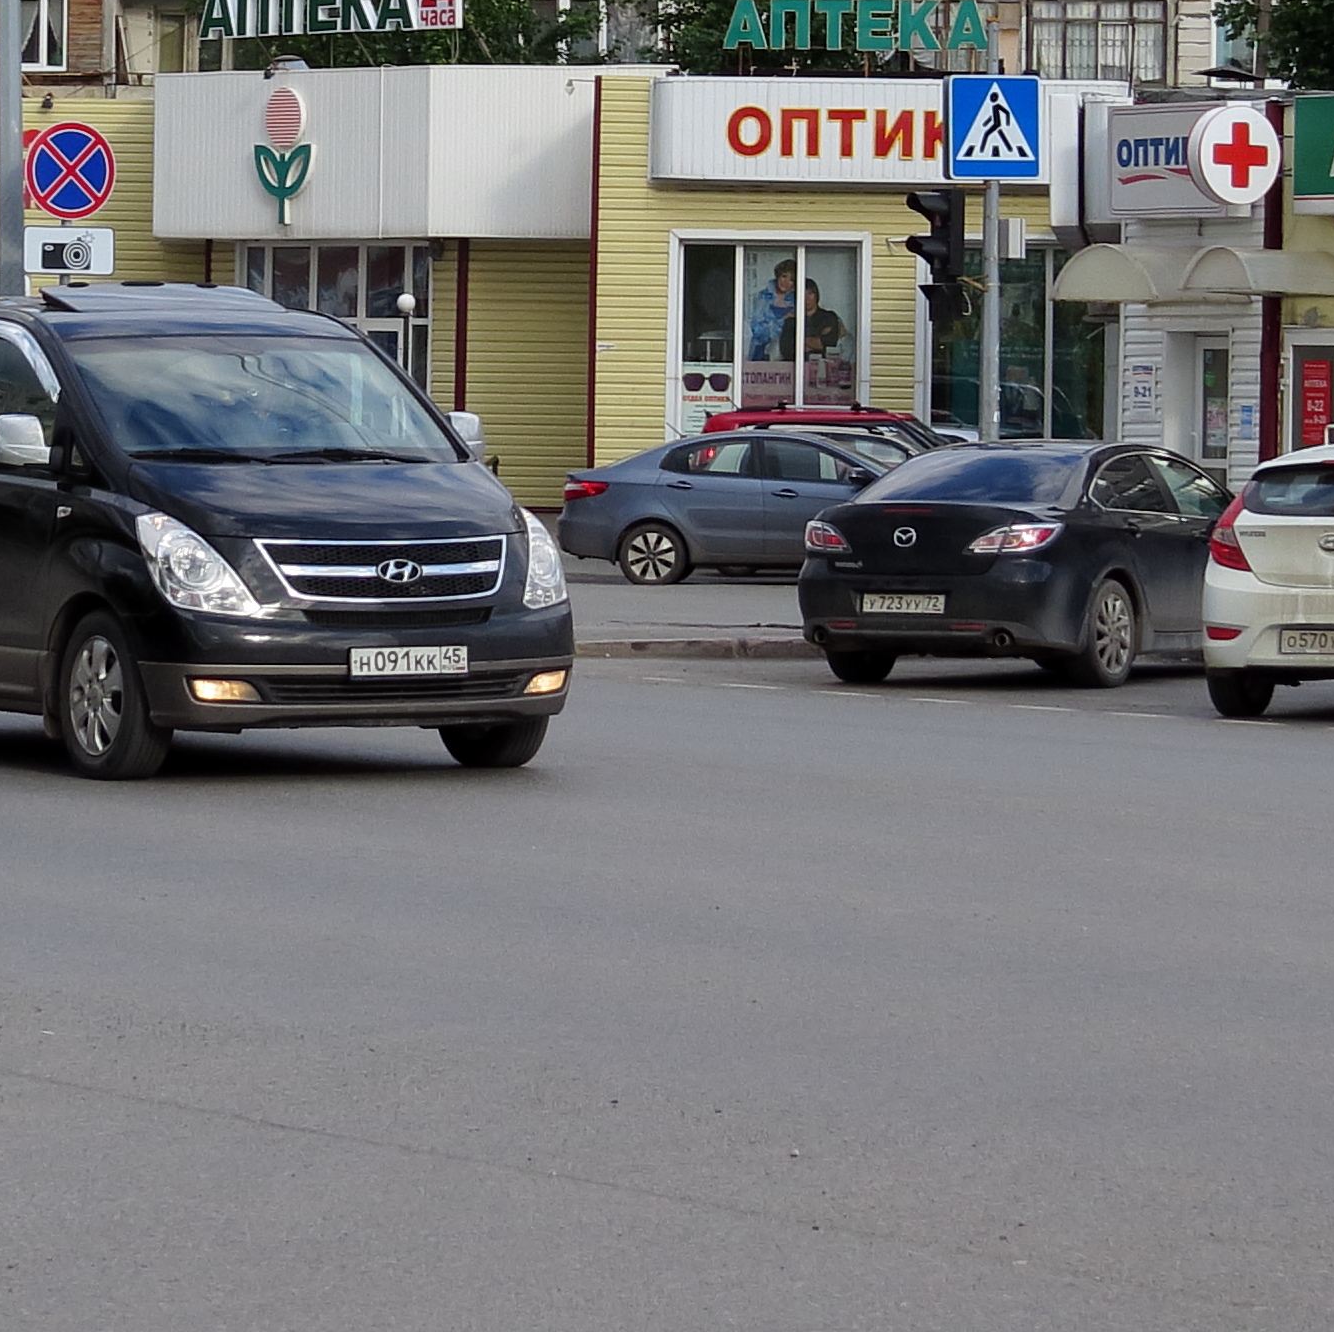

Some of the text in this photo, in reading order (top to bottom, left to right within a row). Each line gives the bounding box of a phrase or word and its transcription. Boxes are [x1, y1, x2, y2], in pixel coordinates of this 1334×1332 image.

[420, 8, 455, 26] часа
[359, 647, 461, 673] Н091КК 45
